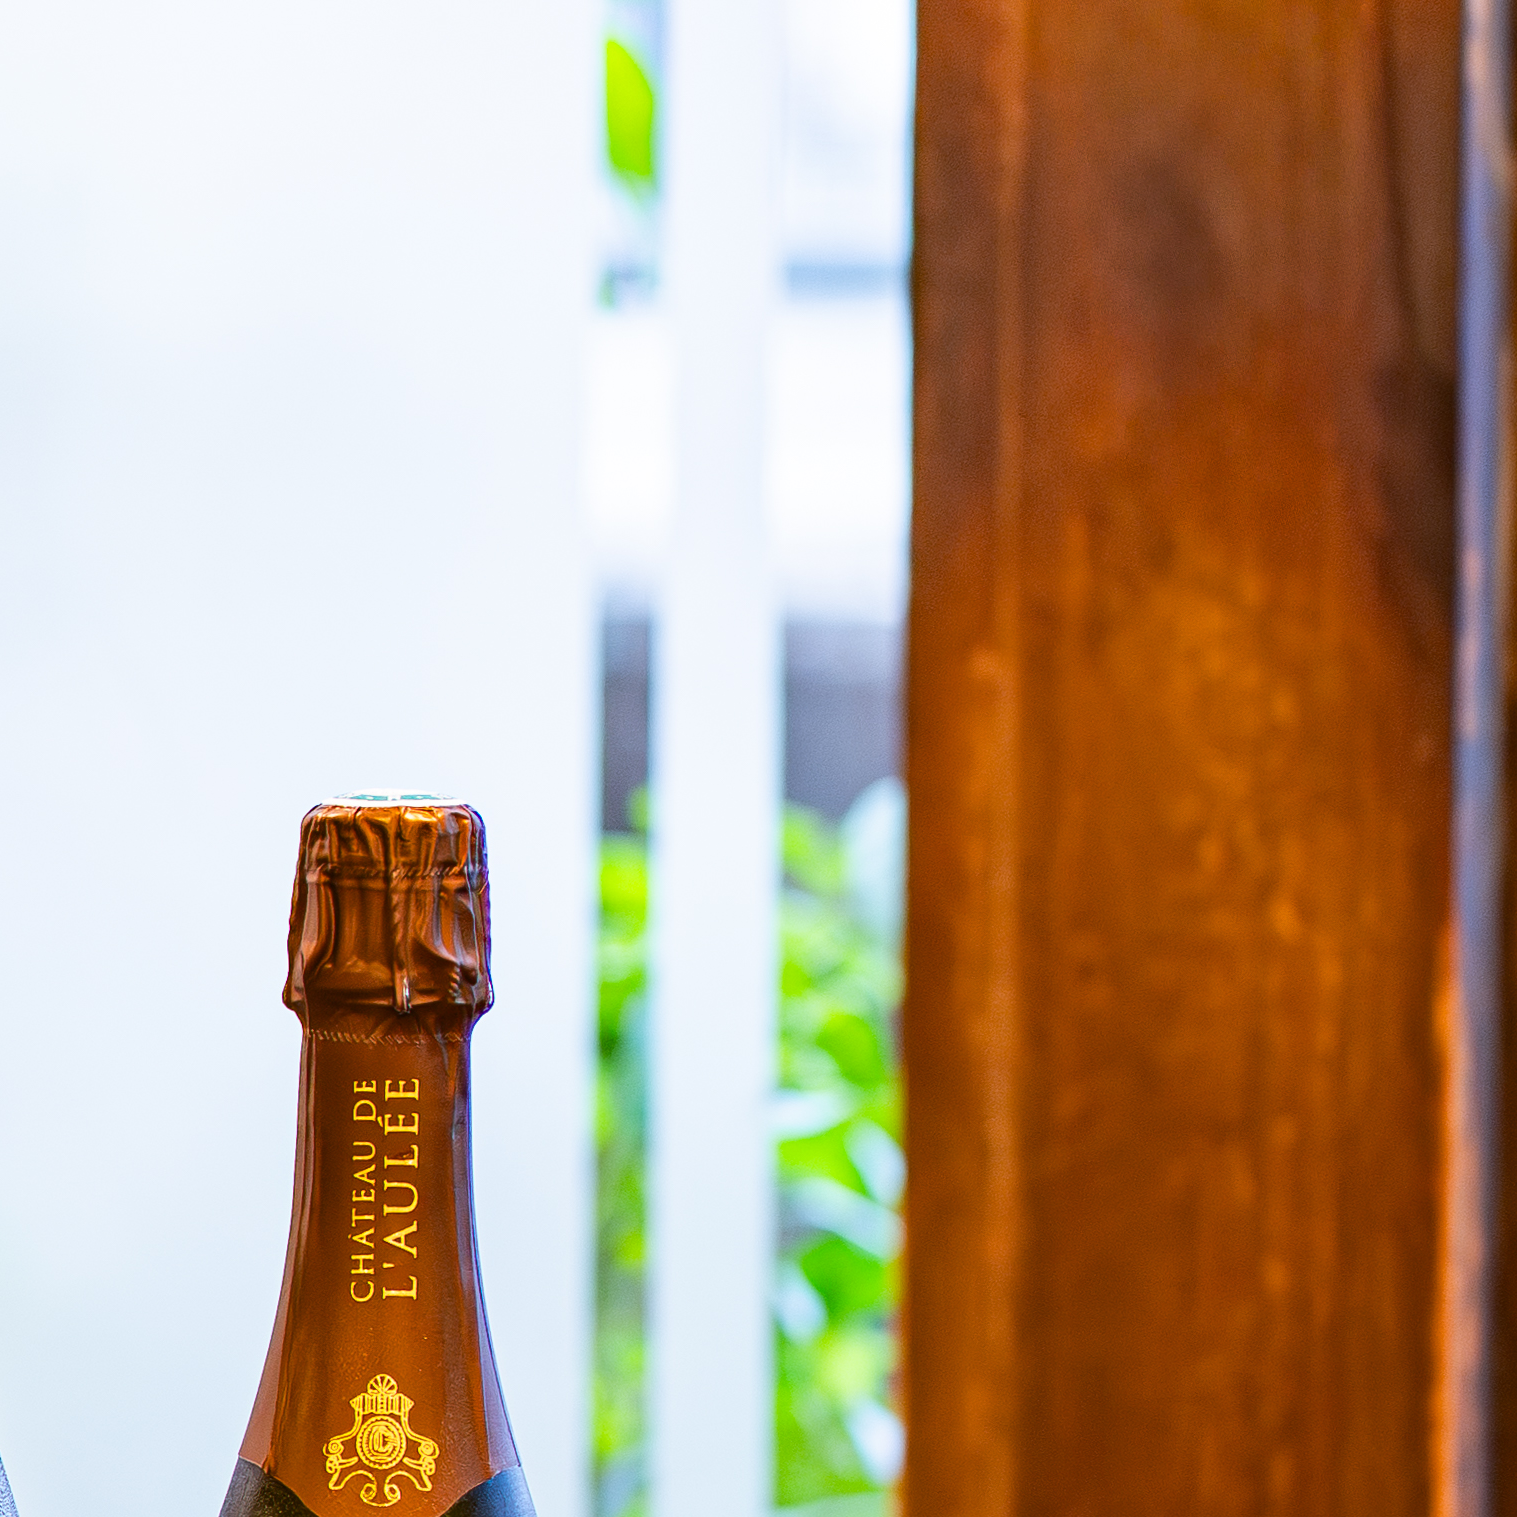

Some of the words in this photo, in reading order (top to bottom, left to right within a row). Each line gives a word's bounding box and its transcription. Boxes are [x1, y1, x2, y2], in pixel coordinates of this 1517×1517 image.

[353, 1079, 377, 1121] DE
[348, 1141, 377, 1302] CHÂTEAU
[378, 1078, 420, 1300] L'AULÉE
